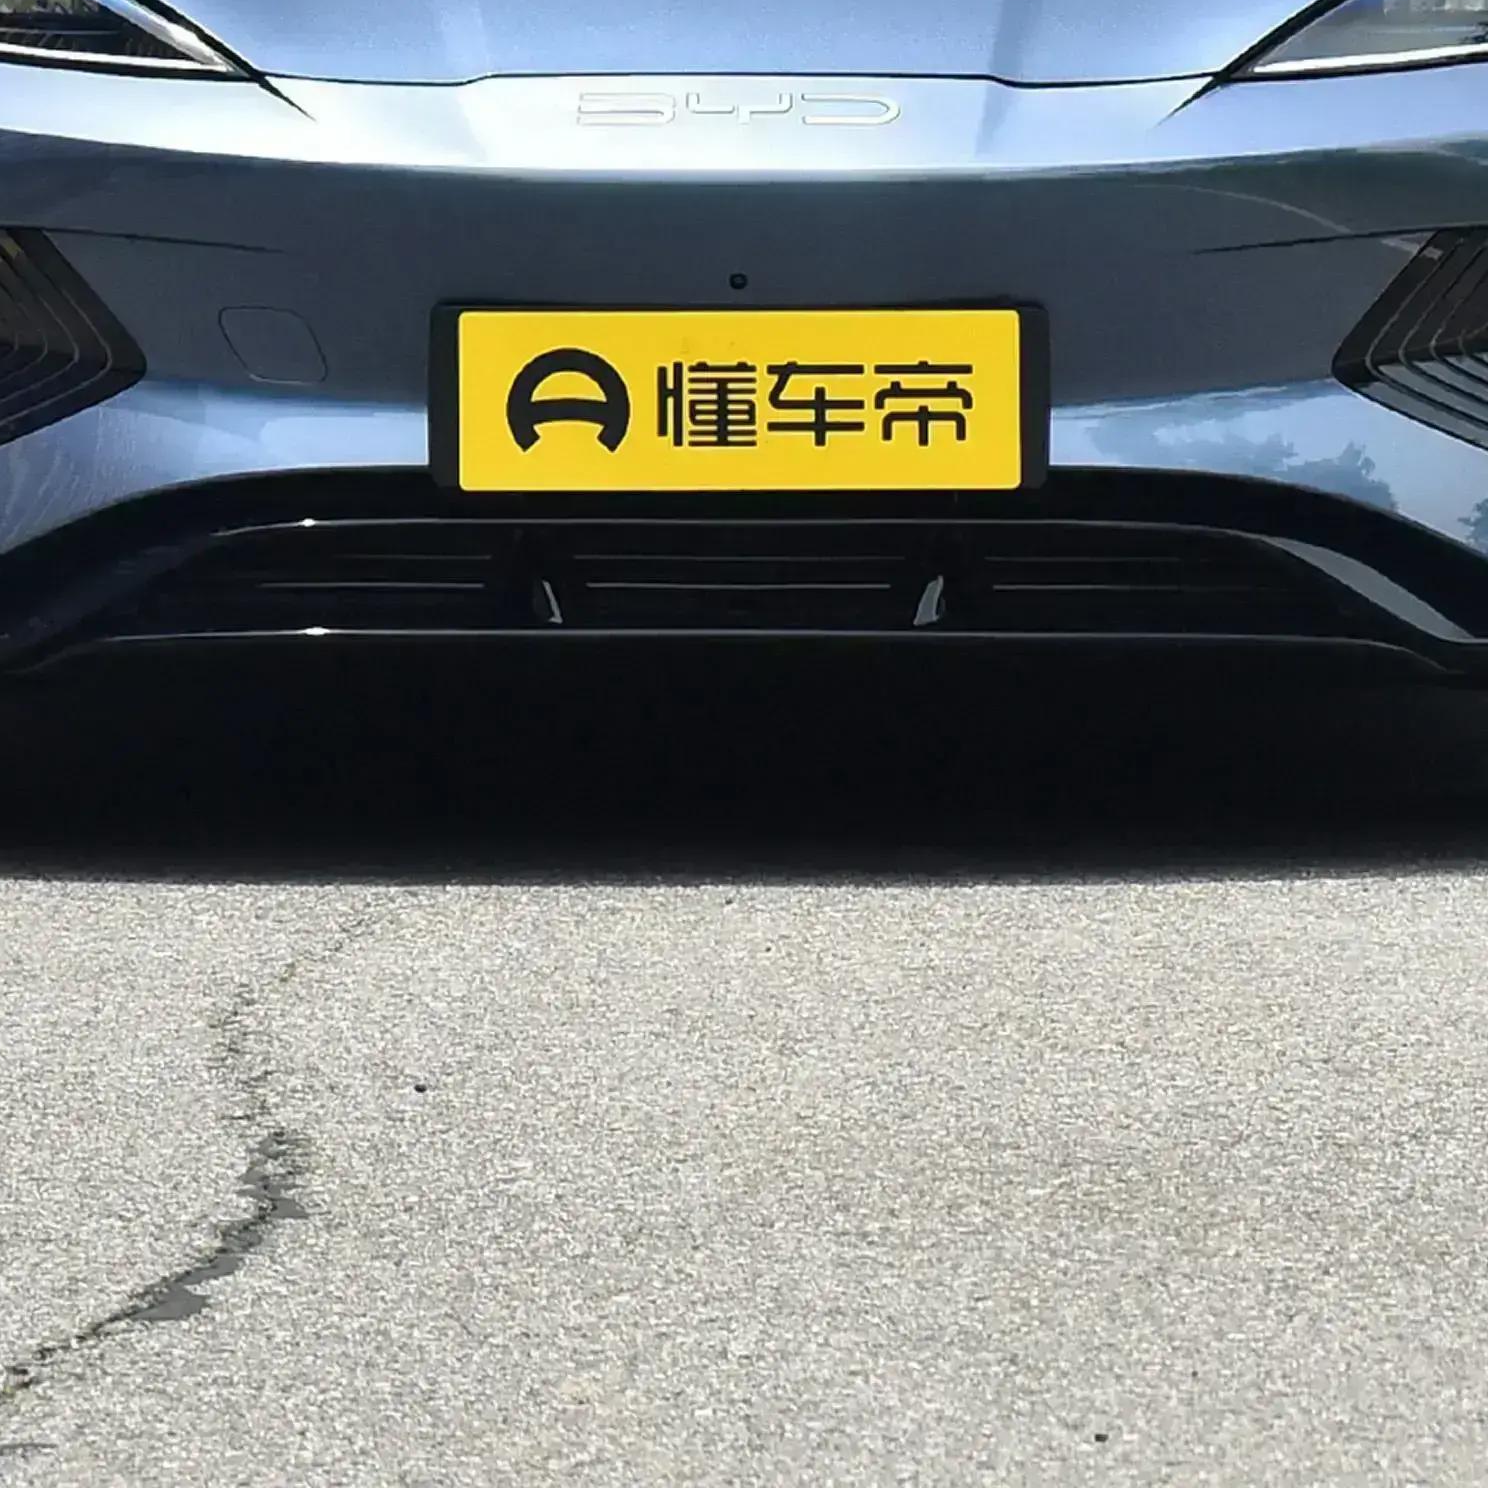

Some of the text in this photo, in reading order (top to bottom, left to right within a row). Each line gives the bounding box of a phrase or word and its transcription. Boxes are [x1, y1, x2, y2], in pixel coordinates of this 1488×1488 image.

[576, 92, 901, 125] BYD
[655, 360, 975, 449] 懂车帝
